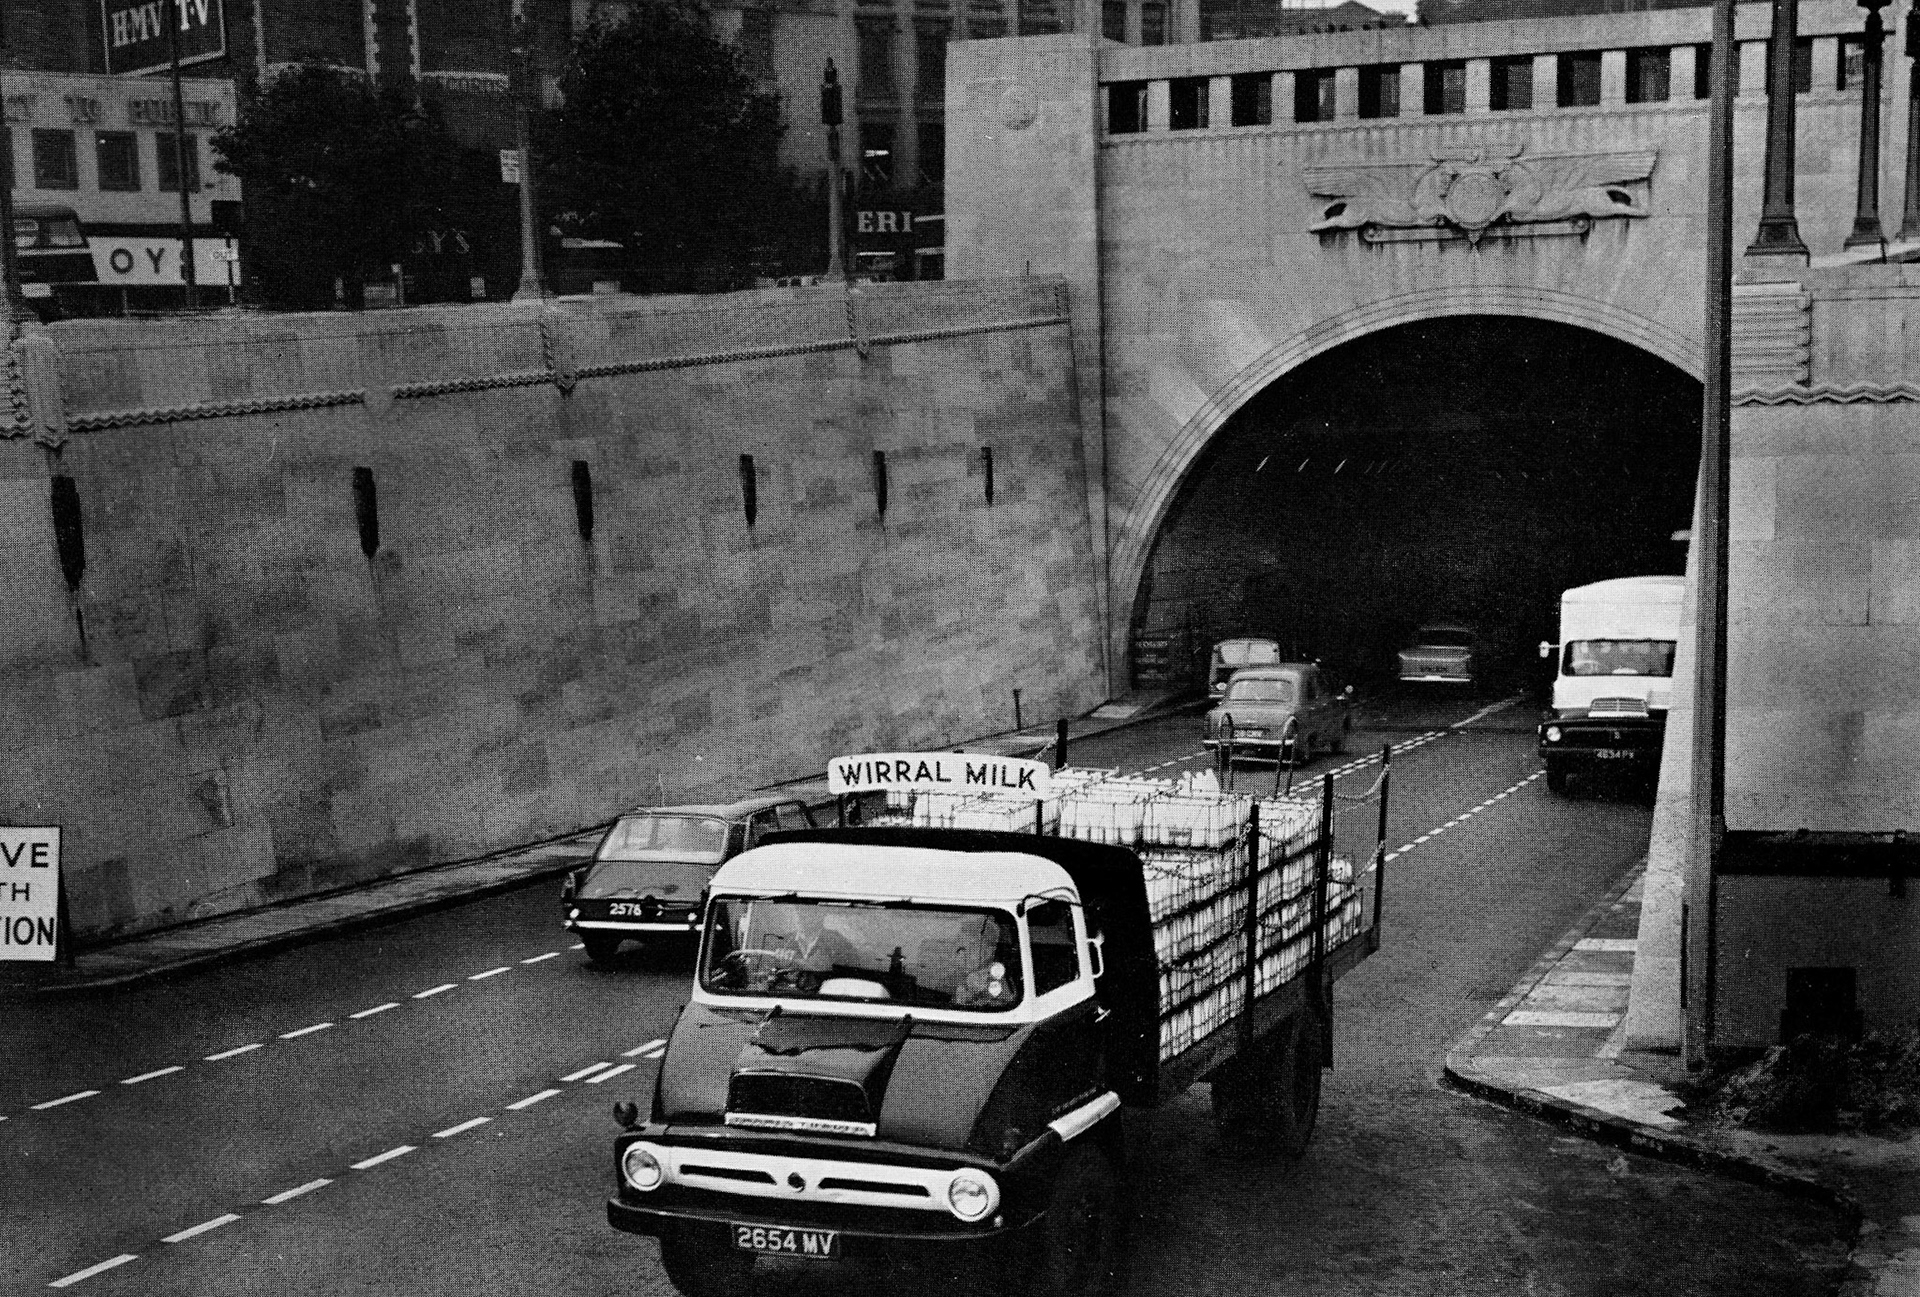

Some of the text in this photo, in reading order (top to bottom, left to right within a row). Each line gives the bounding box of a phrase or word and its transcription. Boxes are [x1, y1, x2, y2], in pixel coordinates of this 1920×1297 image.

[857, 210, 913, 233] ERI
[838, 760, 1037, 791] WIRRAL MILK
[0, 916, 54, 946] ION
[737, 1226, 836, 1255] 2654 MV
